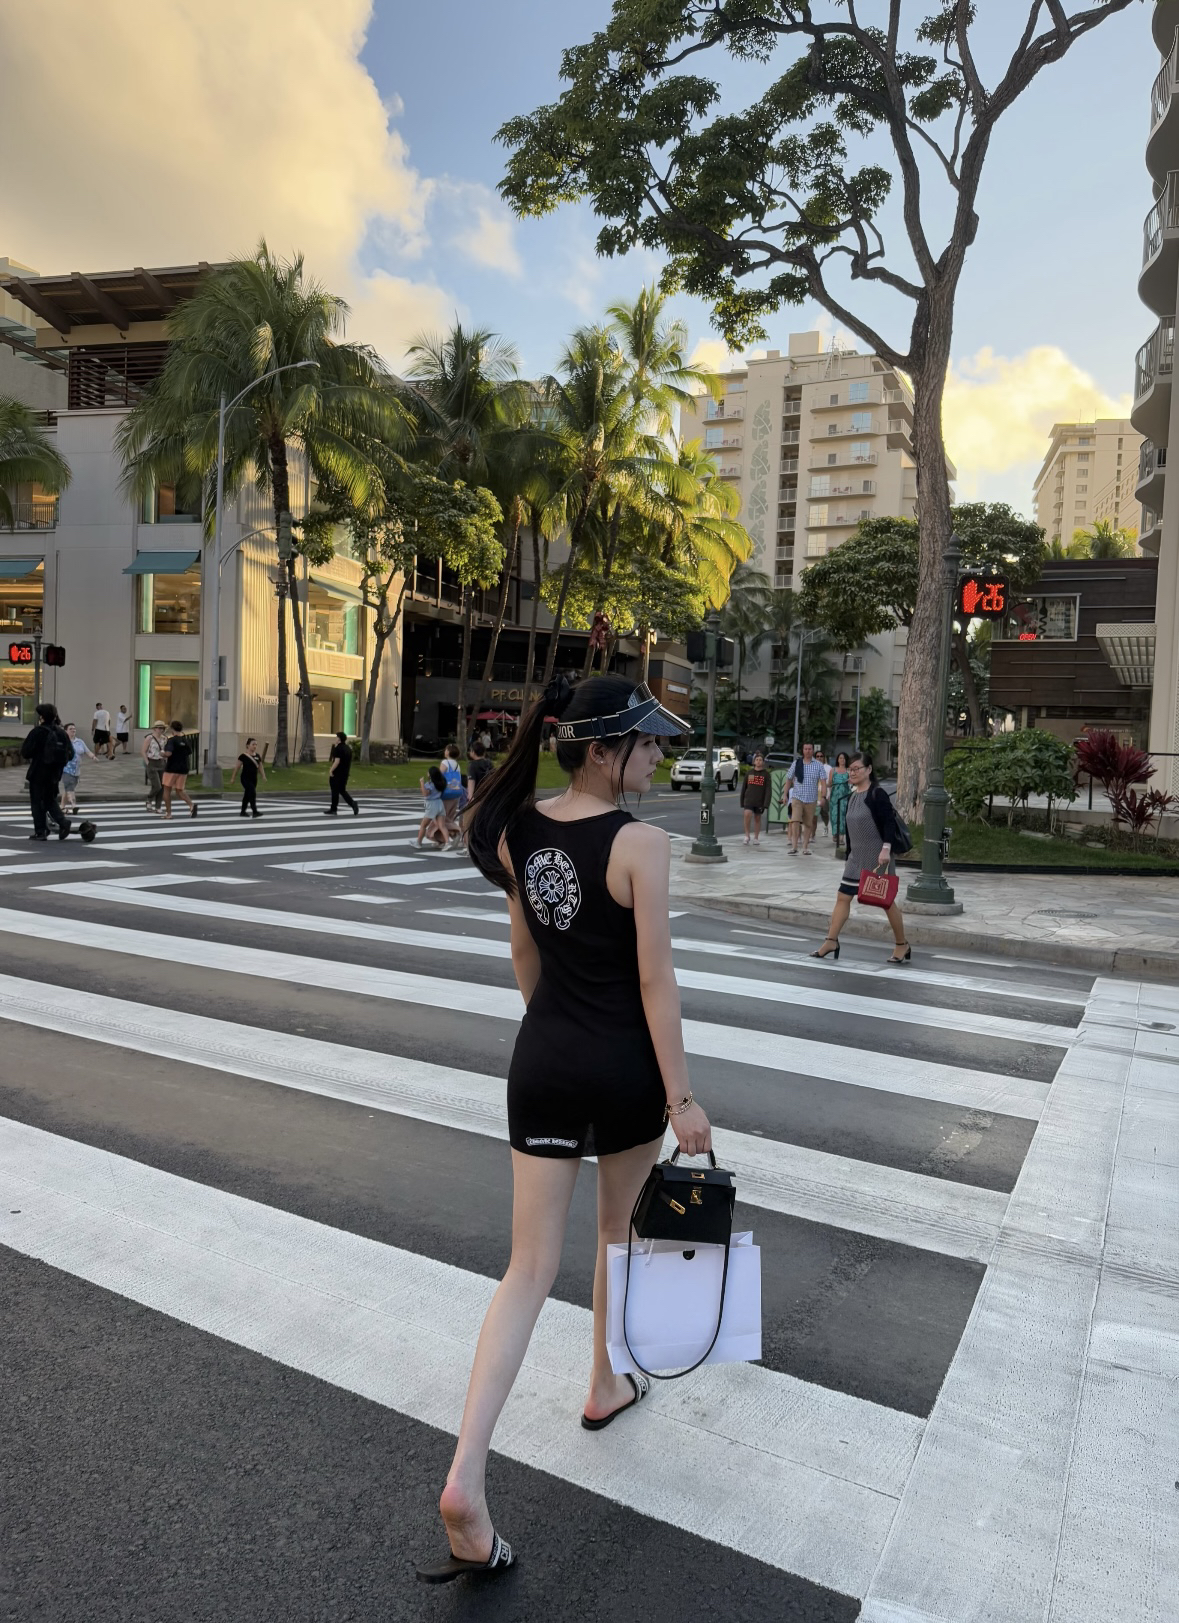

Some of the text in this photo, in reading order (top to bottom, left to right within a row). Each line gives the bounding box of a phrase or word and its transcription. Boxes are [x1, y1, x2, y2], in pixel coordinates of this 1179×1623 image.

[982, 583, 1004, 611] 26
[1019, 633, 1037, 641] OPEN
[21, 647, 31, 660] 26
